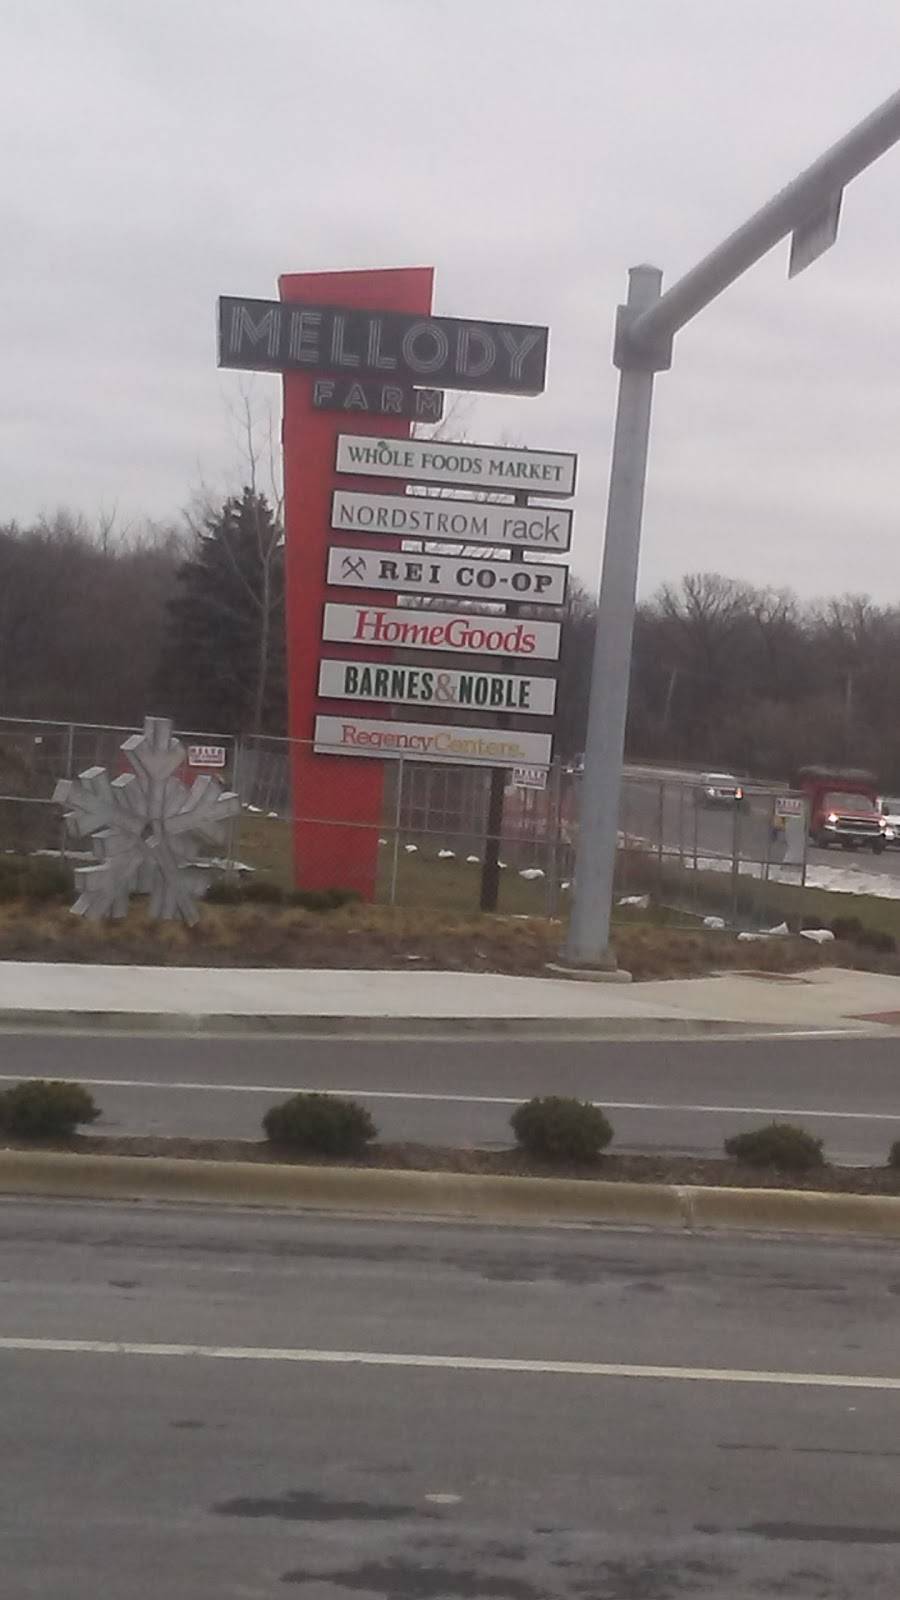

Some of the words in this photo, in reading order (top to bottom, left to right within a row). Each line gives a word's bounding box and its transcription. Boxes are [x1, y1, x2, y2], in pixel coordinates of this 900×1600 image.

[229, 306, 540, 380] MELLODY
[313, 379, 442, 416] FARM
[348, 445, 414, 468] WHOLE
[422, 453, 482, 474] FOODS
[489, 459, 564, 482] MARKET
[340, 504, 488, 536] NORDSTROM
[503, 516, 560, 542] rack
[379, 560, 440, 583] REI
[456, 567, 553, 593] CO-OP
[353, 609, 536, 653] HomeGoods
